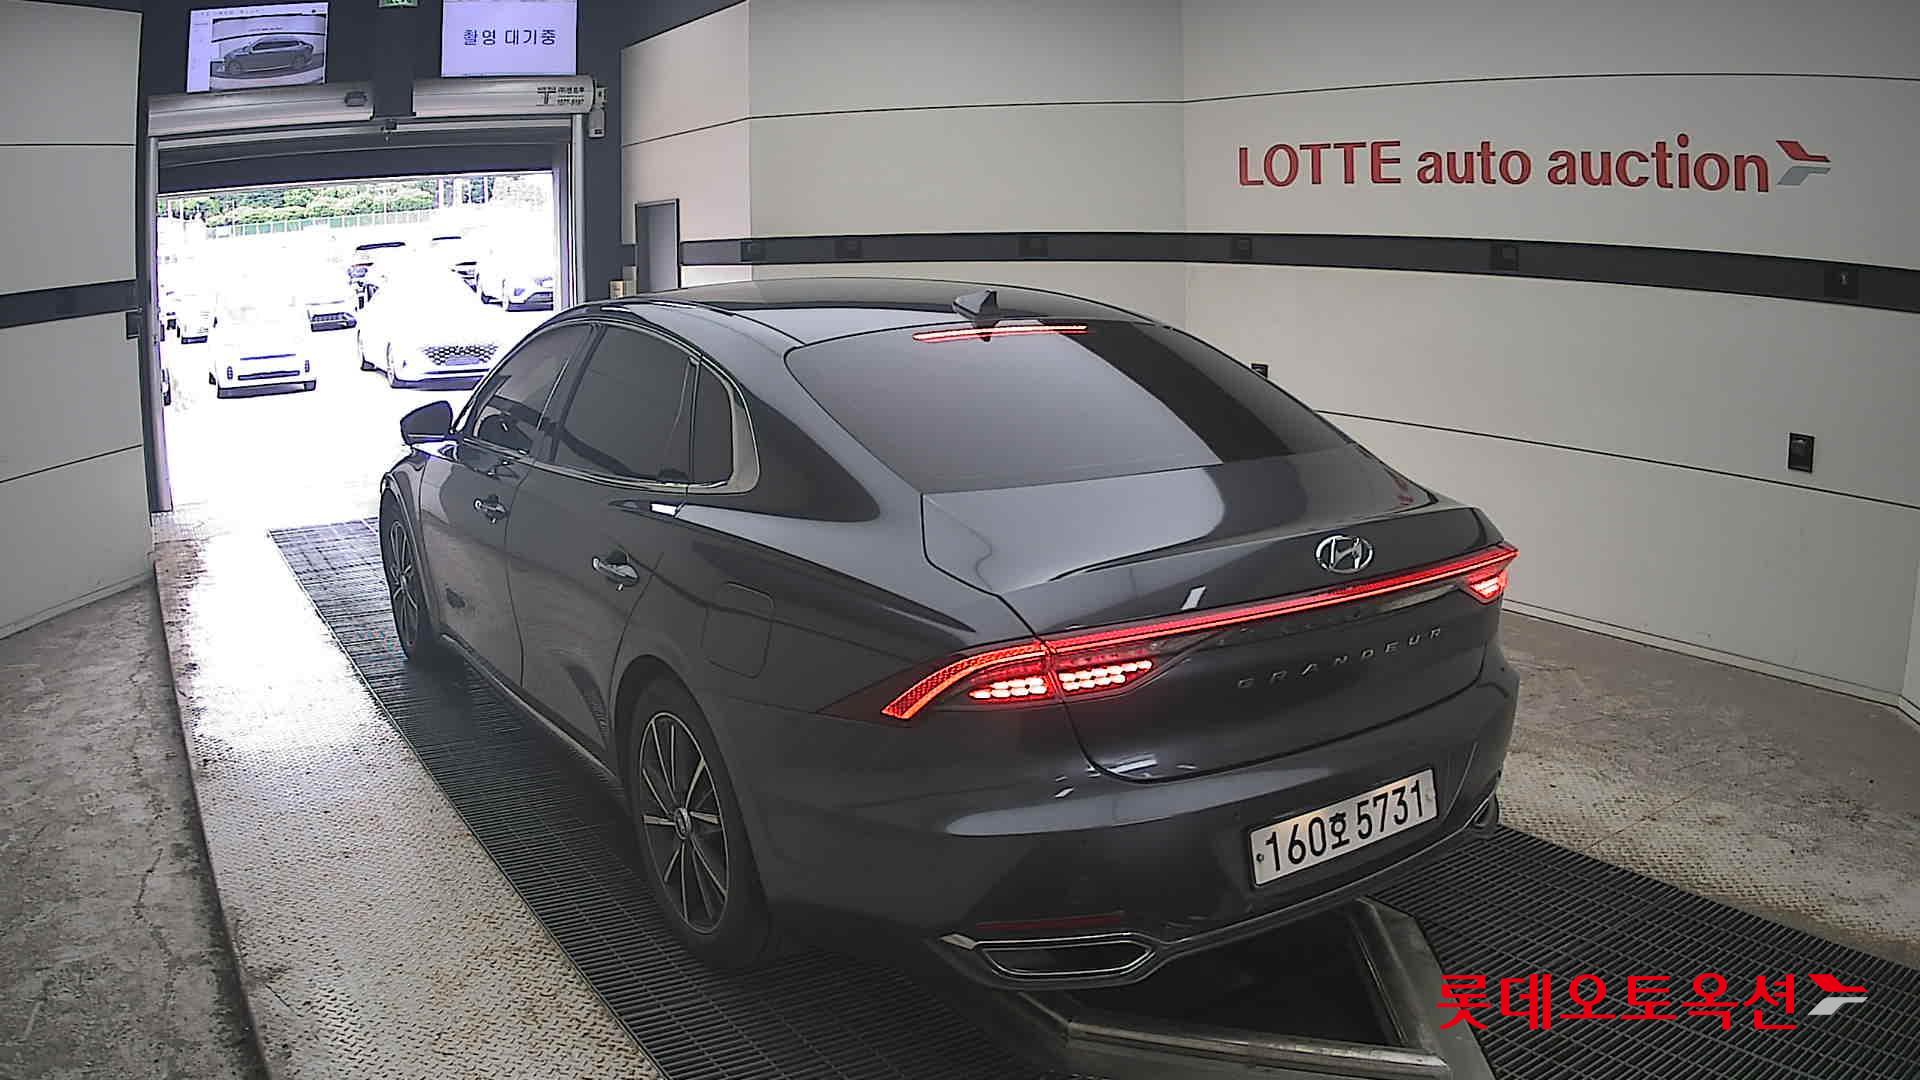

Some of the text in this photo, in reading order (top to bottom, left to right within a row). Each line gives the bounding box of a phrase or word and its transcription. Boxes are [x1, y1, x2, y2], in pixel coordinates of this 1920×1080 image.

[463, 28, 557, 47] 촬영 대기중
[1239, 133, 1770, 193] LOTTE auto auction
[1237, 626, 1442, 689] GRANDEUR
